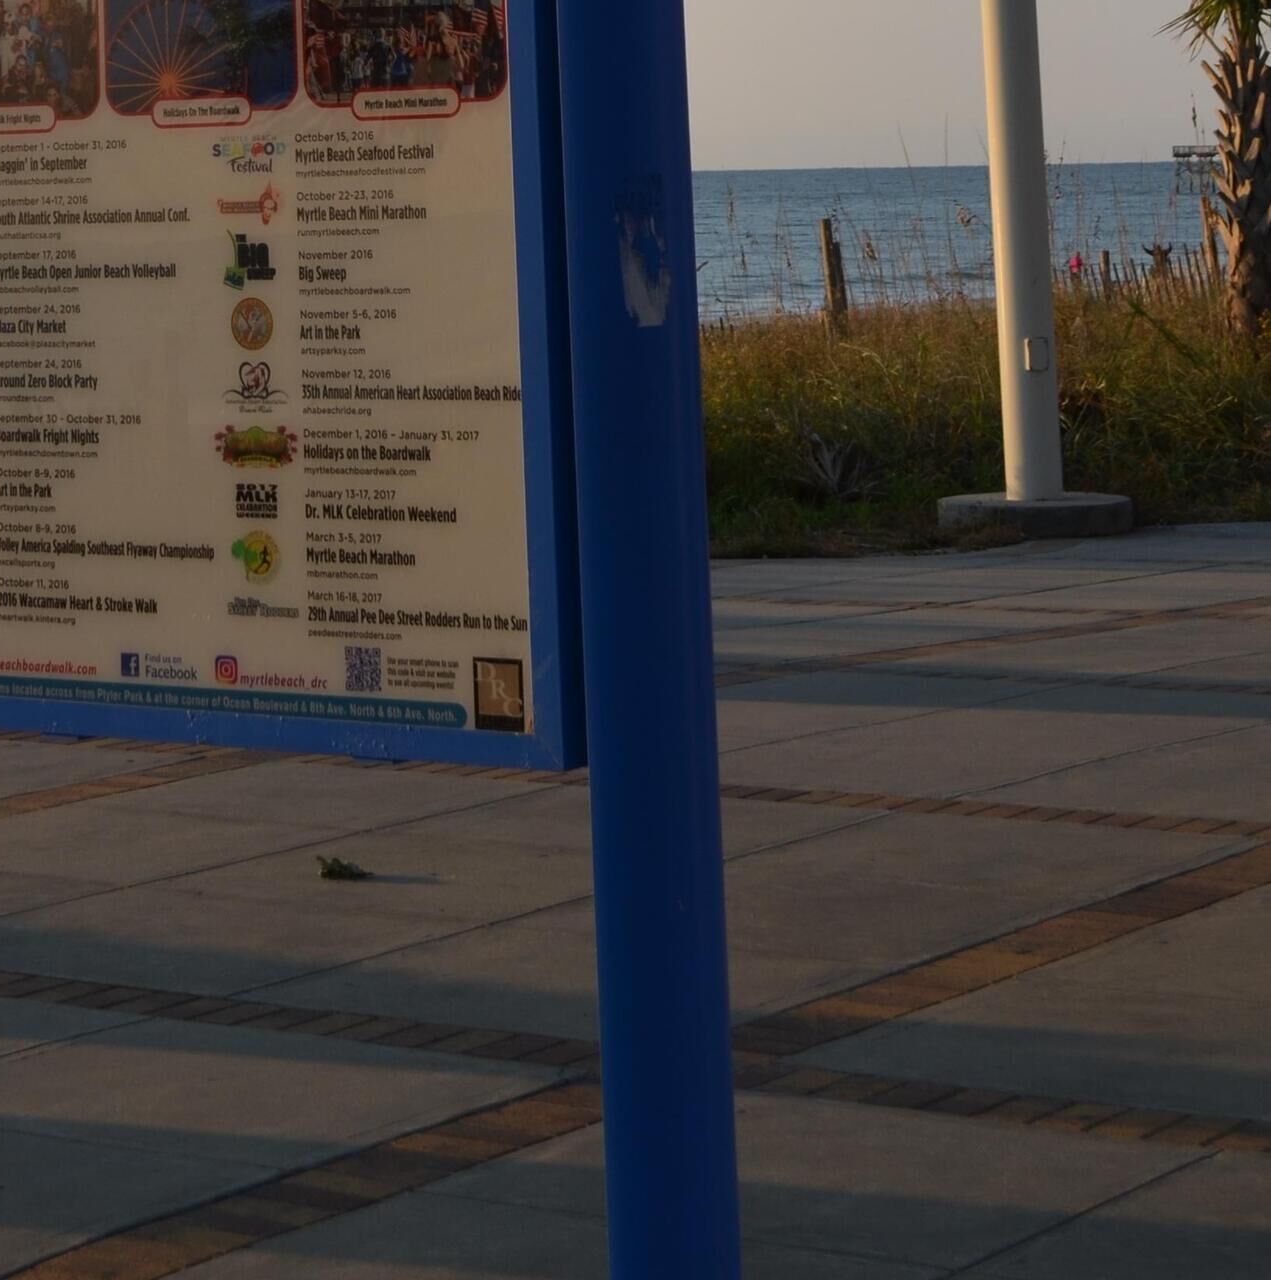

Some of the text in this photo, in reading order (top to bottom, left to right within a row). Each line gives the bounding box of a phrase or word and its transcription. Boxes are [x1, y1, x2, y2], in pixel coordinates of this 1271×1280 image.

[163, 105, 241, 118] Holidays On The Boardwalk
[364, 96, 448, 111] Myrtle Beach Mini Marathon
[212, 141, 286, 158] SEAFOOD
[295, 144, 434, 164] Myrtle Beach Seafood Festival
[30, 157, 38, 171] in
[40, 157, 87, 172] September
[228, 156, 273, 174] Festival
[41, 195, 65, 206] 14-17,
[67, 195, 88, 205] 2016
[296, 190, 394, 201] October 22-23, 2016
[18, 211, 51, 225] Atlantic
[52, 210, 80, 224] Shrine
[82, 209, 132, 224] Association
[134, 208, 166, 223] Annual
[167, 207, 190, 222] Conf.
[296, 205, 427, 223] Myrtle Beach Mini Marathon
[21, 265, 48, 279] Beach
[49, 265, 72, 280] Open
[74, 264, 102, 279] Junior
[103, 264, 130, 278] Beach
[131, 263, 176, 279] Volleyball
[299, 266, 347, 283] Big Sweep
[17, 319, 34, 335] City
[36, 320, 66, 333] Market
[300, 325, 360, 339] Art in the Park
[301, 368, 391, 379] November 12, 2016
[27, 375, 47, 388] Zero
[48, 375, 72, 388] Block
[74, 375, 98, 390] Party
[302, 384, 321, 399] 35th
[322, 384, 352, 399] Annual
[354, 385, 395, 400] American
[396, 385, 420, 400] Heart
[422, 385, 472, 400] Association
[474, 385, 501, 401] Beach
[66, 414, 103, 424] October
[106, 414, 118, 425] 31,
[120, 414, 141, 424] 2016
[43, 429, 68, 445] Fright
[71, 429, 99, 445] Nights
[303, 445, 431, 461] Holidays on the Boardwalk
[9, 483, 17, 496] in
[18, 483, 32, 497] the
[34, 483, 52, 498] Park
[236, 490, 278, 503] MLK
[304, 489, 396, 500] January 13-17, 2017
[305, 504, 457, 522] Dr. MLK Celebration Weekend
[20, 539, 51, 553] America
[52, 539, 86, 556] Spalding
[87, 541, 125, 556] Southeast
[126, 542, 157, 559] Flyaway
[159, 543, 215, 560] Championship
[306, 547, 416, 566] Myrtle Beach Marathon
[18, 593, 67, 609] Waccamaw
[69, 595, 94, 610] Heart
[95, 596, 103, 611] &
[104, 597, 133, 612] Stroke
[135, 598, 157, 613] Walk
[308, 606, 327, 621] 29th
[328, 608, 359, 623] Annual
[360, 608, 377, 624] Pee
[378, 609, 395, 625] Dee
[396, 610, 423, 626] Street
[425, 612, 461, 627] Rodders
[462, 613, 481, 629] Run
[482, 615, 492, 630] to
[493, 615, 509, 630] the
[510, 615, 528, 631] Sun
[144, 653, 182, 664] Find us on
[145, 665, 197, 680] Facebook
[239, 674, 327, 689] myrtlebeach_drc
[45, 687, 73, 699] across
[75, 687, 95, 700] from
[124, 690, 144, 703] Park
[145, 690, 152, 703] &
[153, 692, 163, 705] at
[164, 692, 179, 704] the
[181, 695, 209, 706] corner
[211, 695, 221, 707] of
[222, 695, 251, 709] Ocean
[252, 697, 298, 712] Boulevard
[300, 700, 307, 713] &
[309, 701, 325, 713] 8th
[349, 703, 375, 717] North
[377, 705, 384, 718] &
[386, 705, 402, 718] 6th
